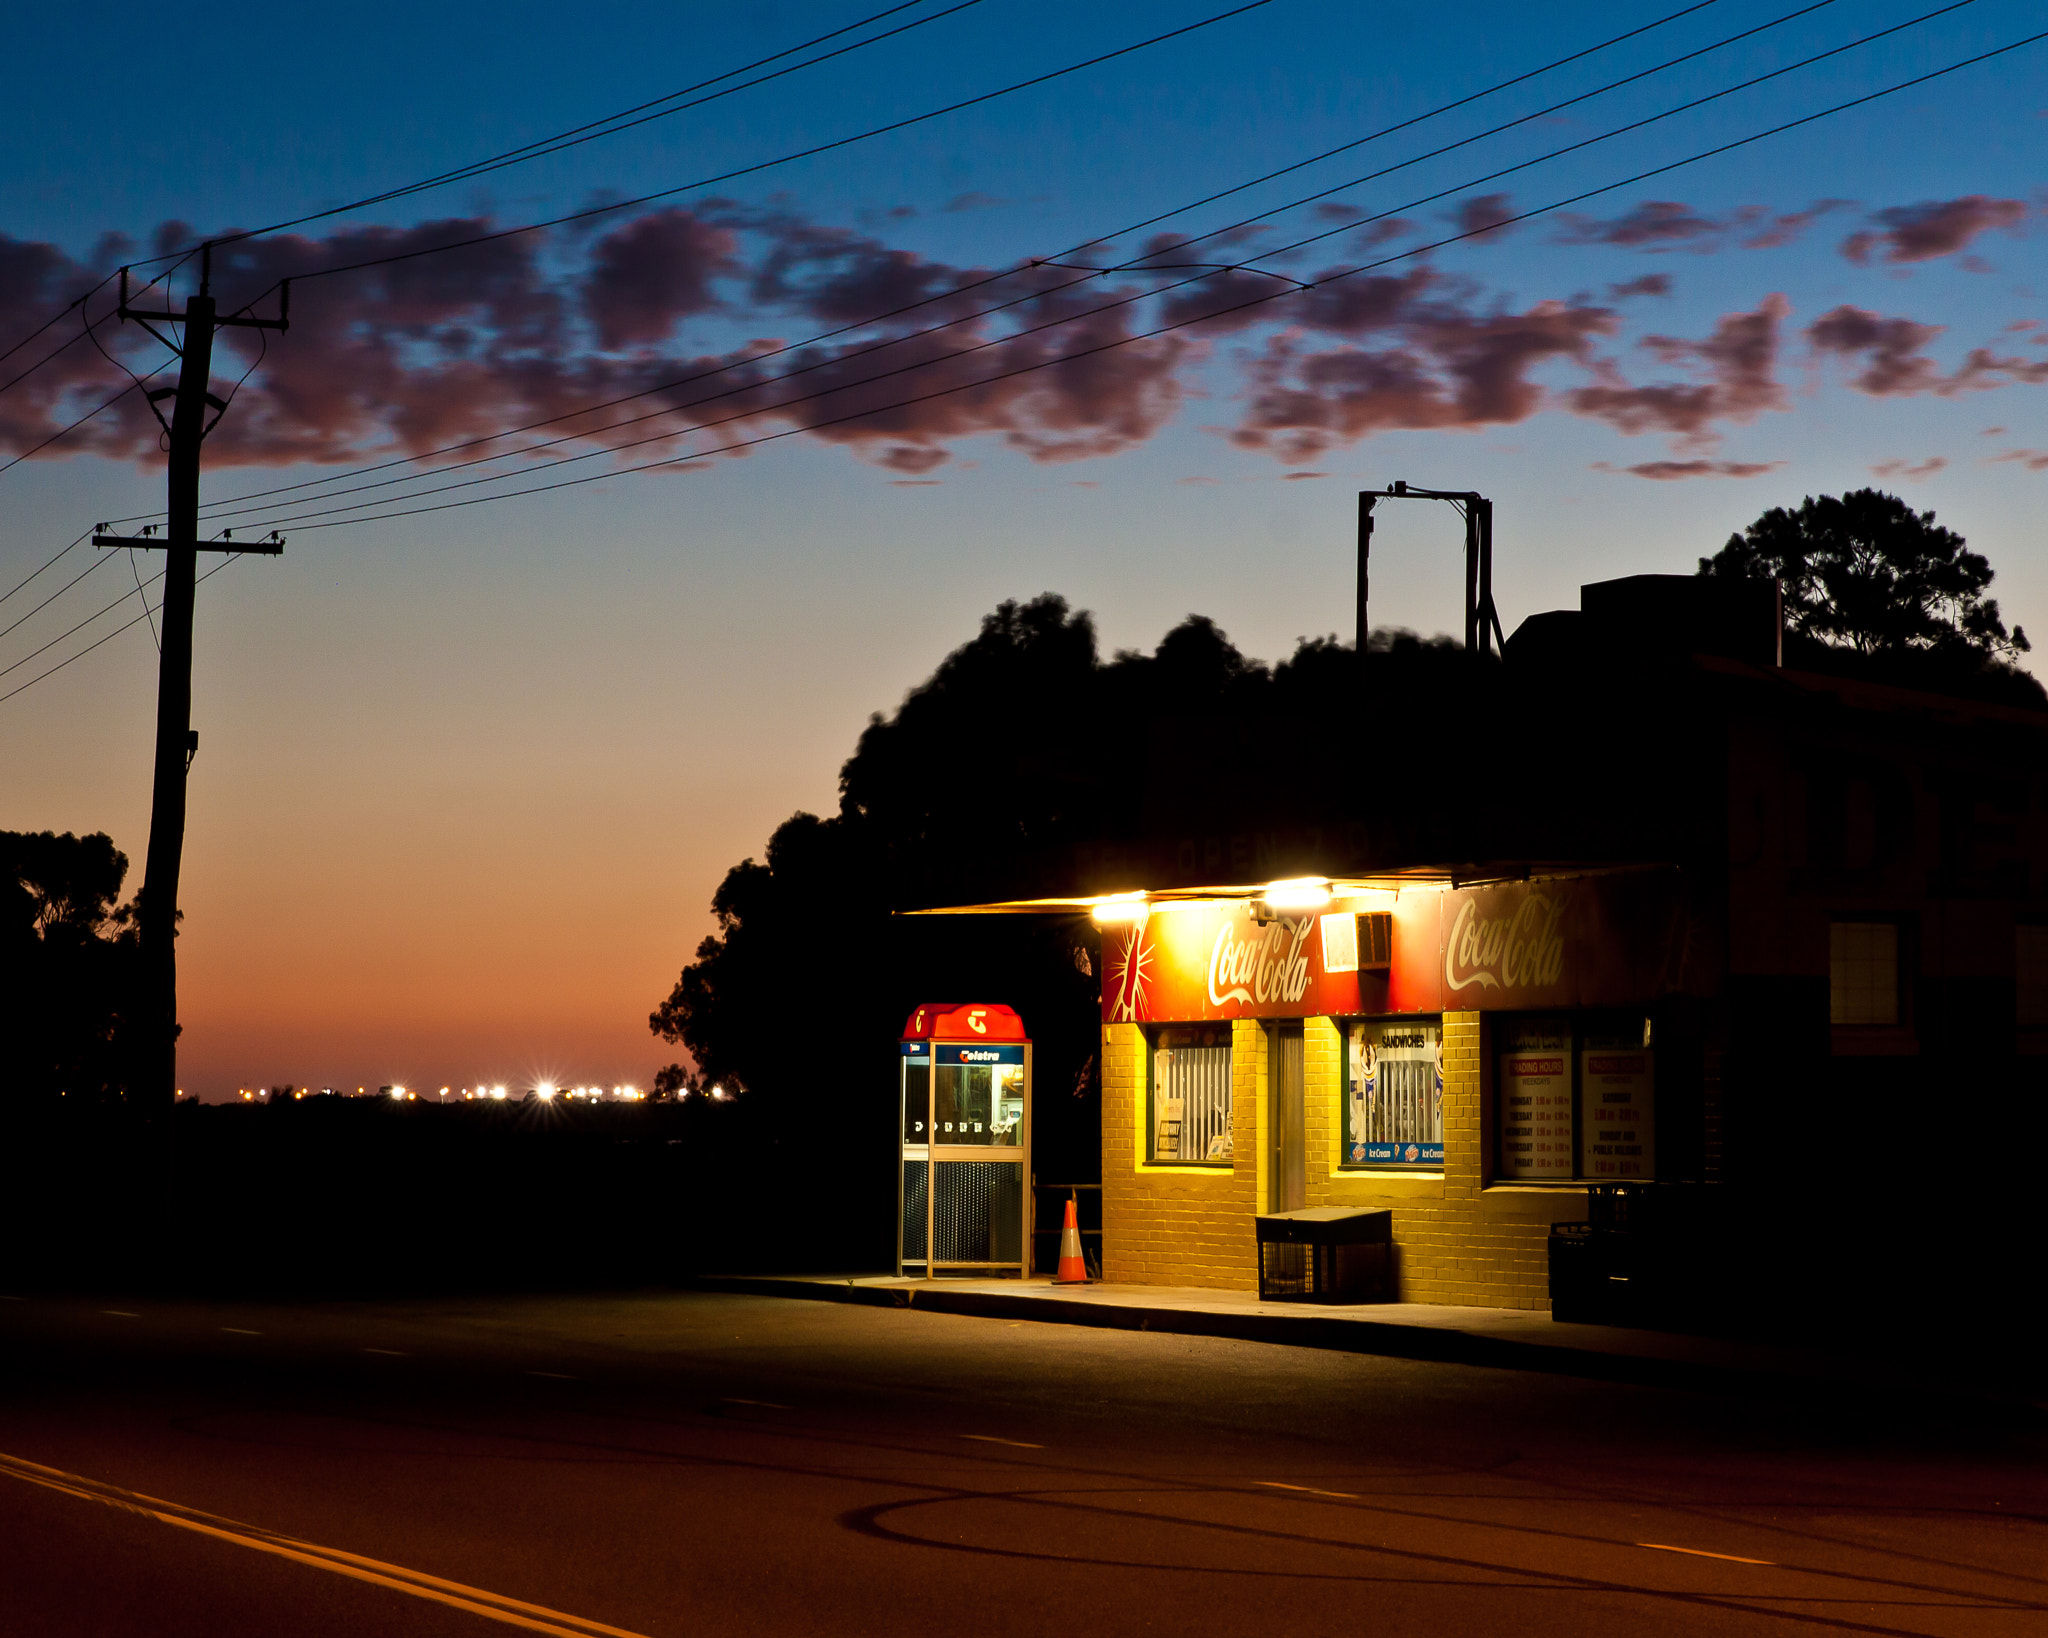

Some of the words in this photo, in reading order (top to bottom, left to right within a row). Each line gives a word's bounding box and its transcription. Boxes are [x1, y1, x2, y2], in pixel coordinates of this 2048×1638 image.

[1446, 893, 1572, 990] Coca-Cola
[1207, 912, 1313, 1005] Coca-Cola
[1382, 1034, 1425, 1048] SANDWICHES
[959, 1050, 1000, 1063] Telstra
[1539, 1061, 1562, 1072] HOURS
[1376, 1148, 1391, 1158] Cream
[1514, 1158, 1533, 1167] FRIDAY
